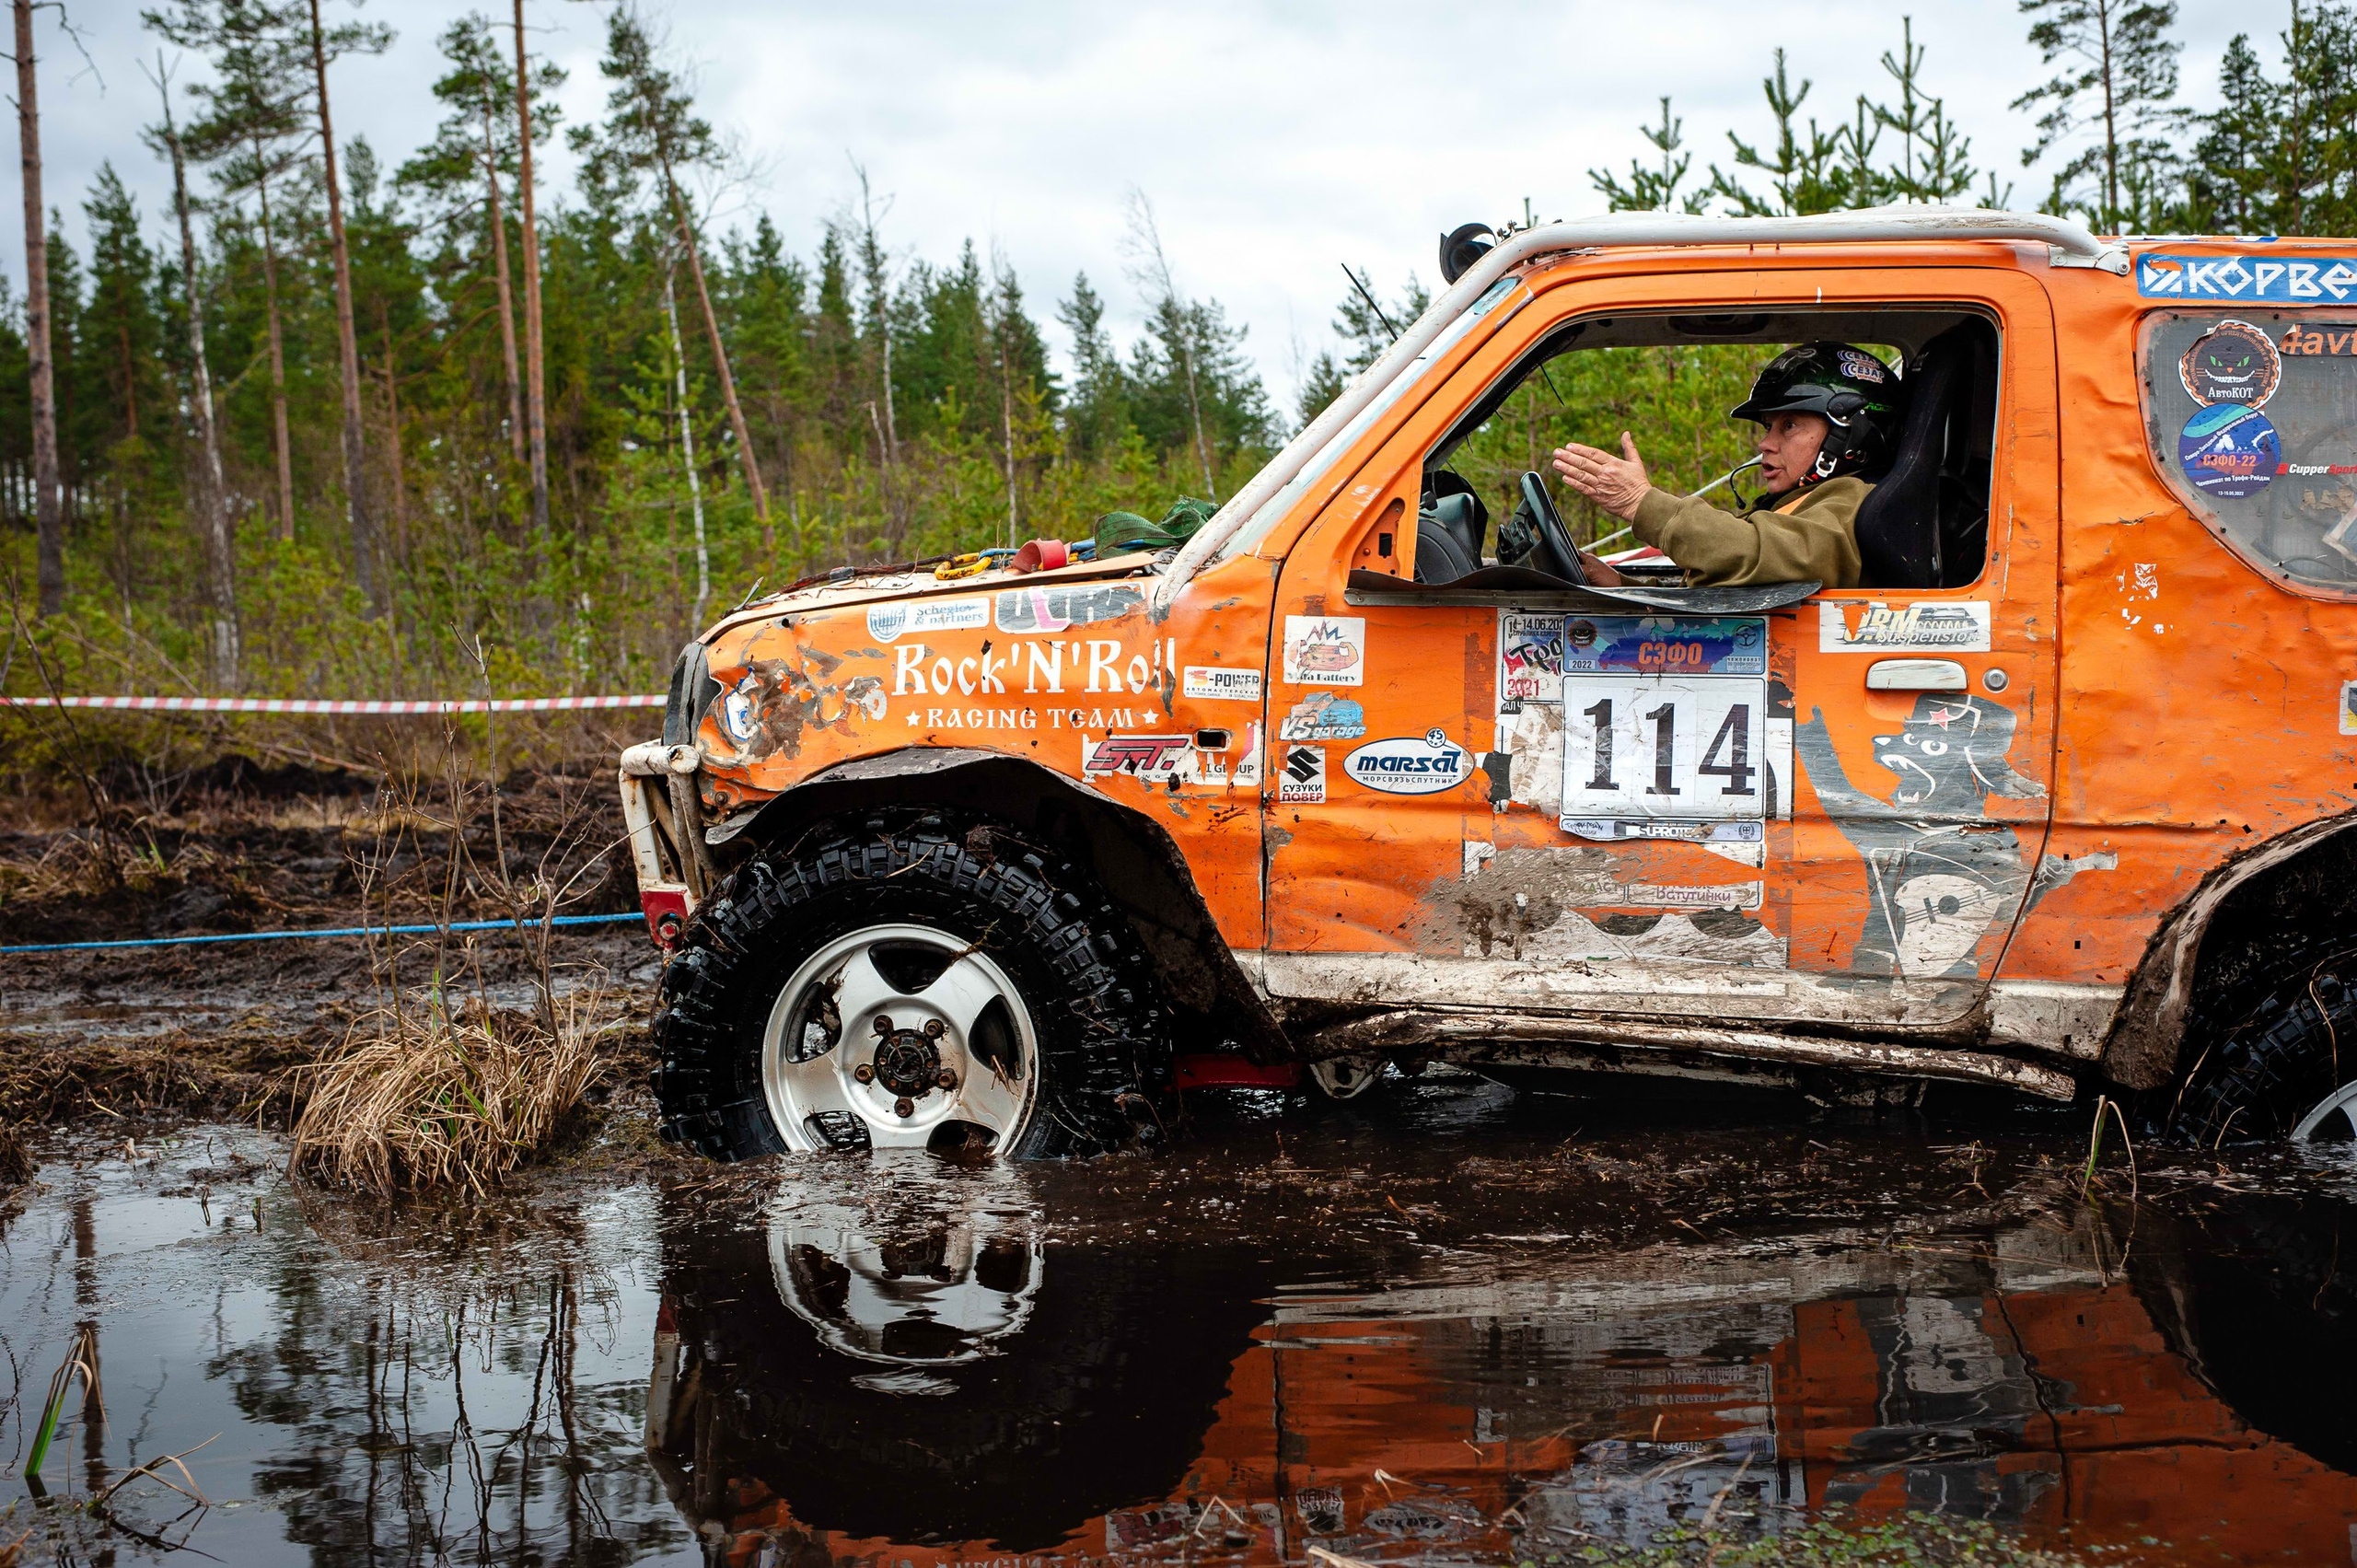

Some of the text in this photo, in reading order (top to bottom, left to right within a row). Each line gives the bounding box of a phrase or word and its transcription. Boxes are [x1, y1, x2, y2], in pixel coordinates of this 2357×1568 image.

[2207, 386, 2254, 399] АвтоКОТ
[2215, 415, 2247, 437] Федеральный
[2202, 454, 2258, 468] СЗФО-22
[2288, 463, 2357, 477] CupperSport
[2195, 478, 2223, 487] Чемпионат
[2231, 474, 2270, 482] Трофи-Рейдам
[915, 616, 924, 626] &
[1877, 629, 1980, 645] Suspension
[1638, 642, 1702, 665] СЗФО
[1572, 660, 1592, 669] 2022
[1188, 670, 1260, 687] S-POWER
[925, 707, 1135, 729] RACING TEAM
[1280, 716, 1317, 740] VS
[1312, 725, 1367, 739] garage
[1428, 729, 1444, 740] 45
[1584, 698, 1756, 796] 114
[1363, 776, 1453, 784] МОРСВЯЗЬСПУТНИК
[1283, 784, 1323, 793] СУЗУКИ
[1282, 793, 1323, 802] ПОВЕР
[1656, 888, 1732, 903] Ватутинки
